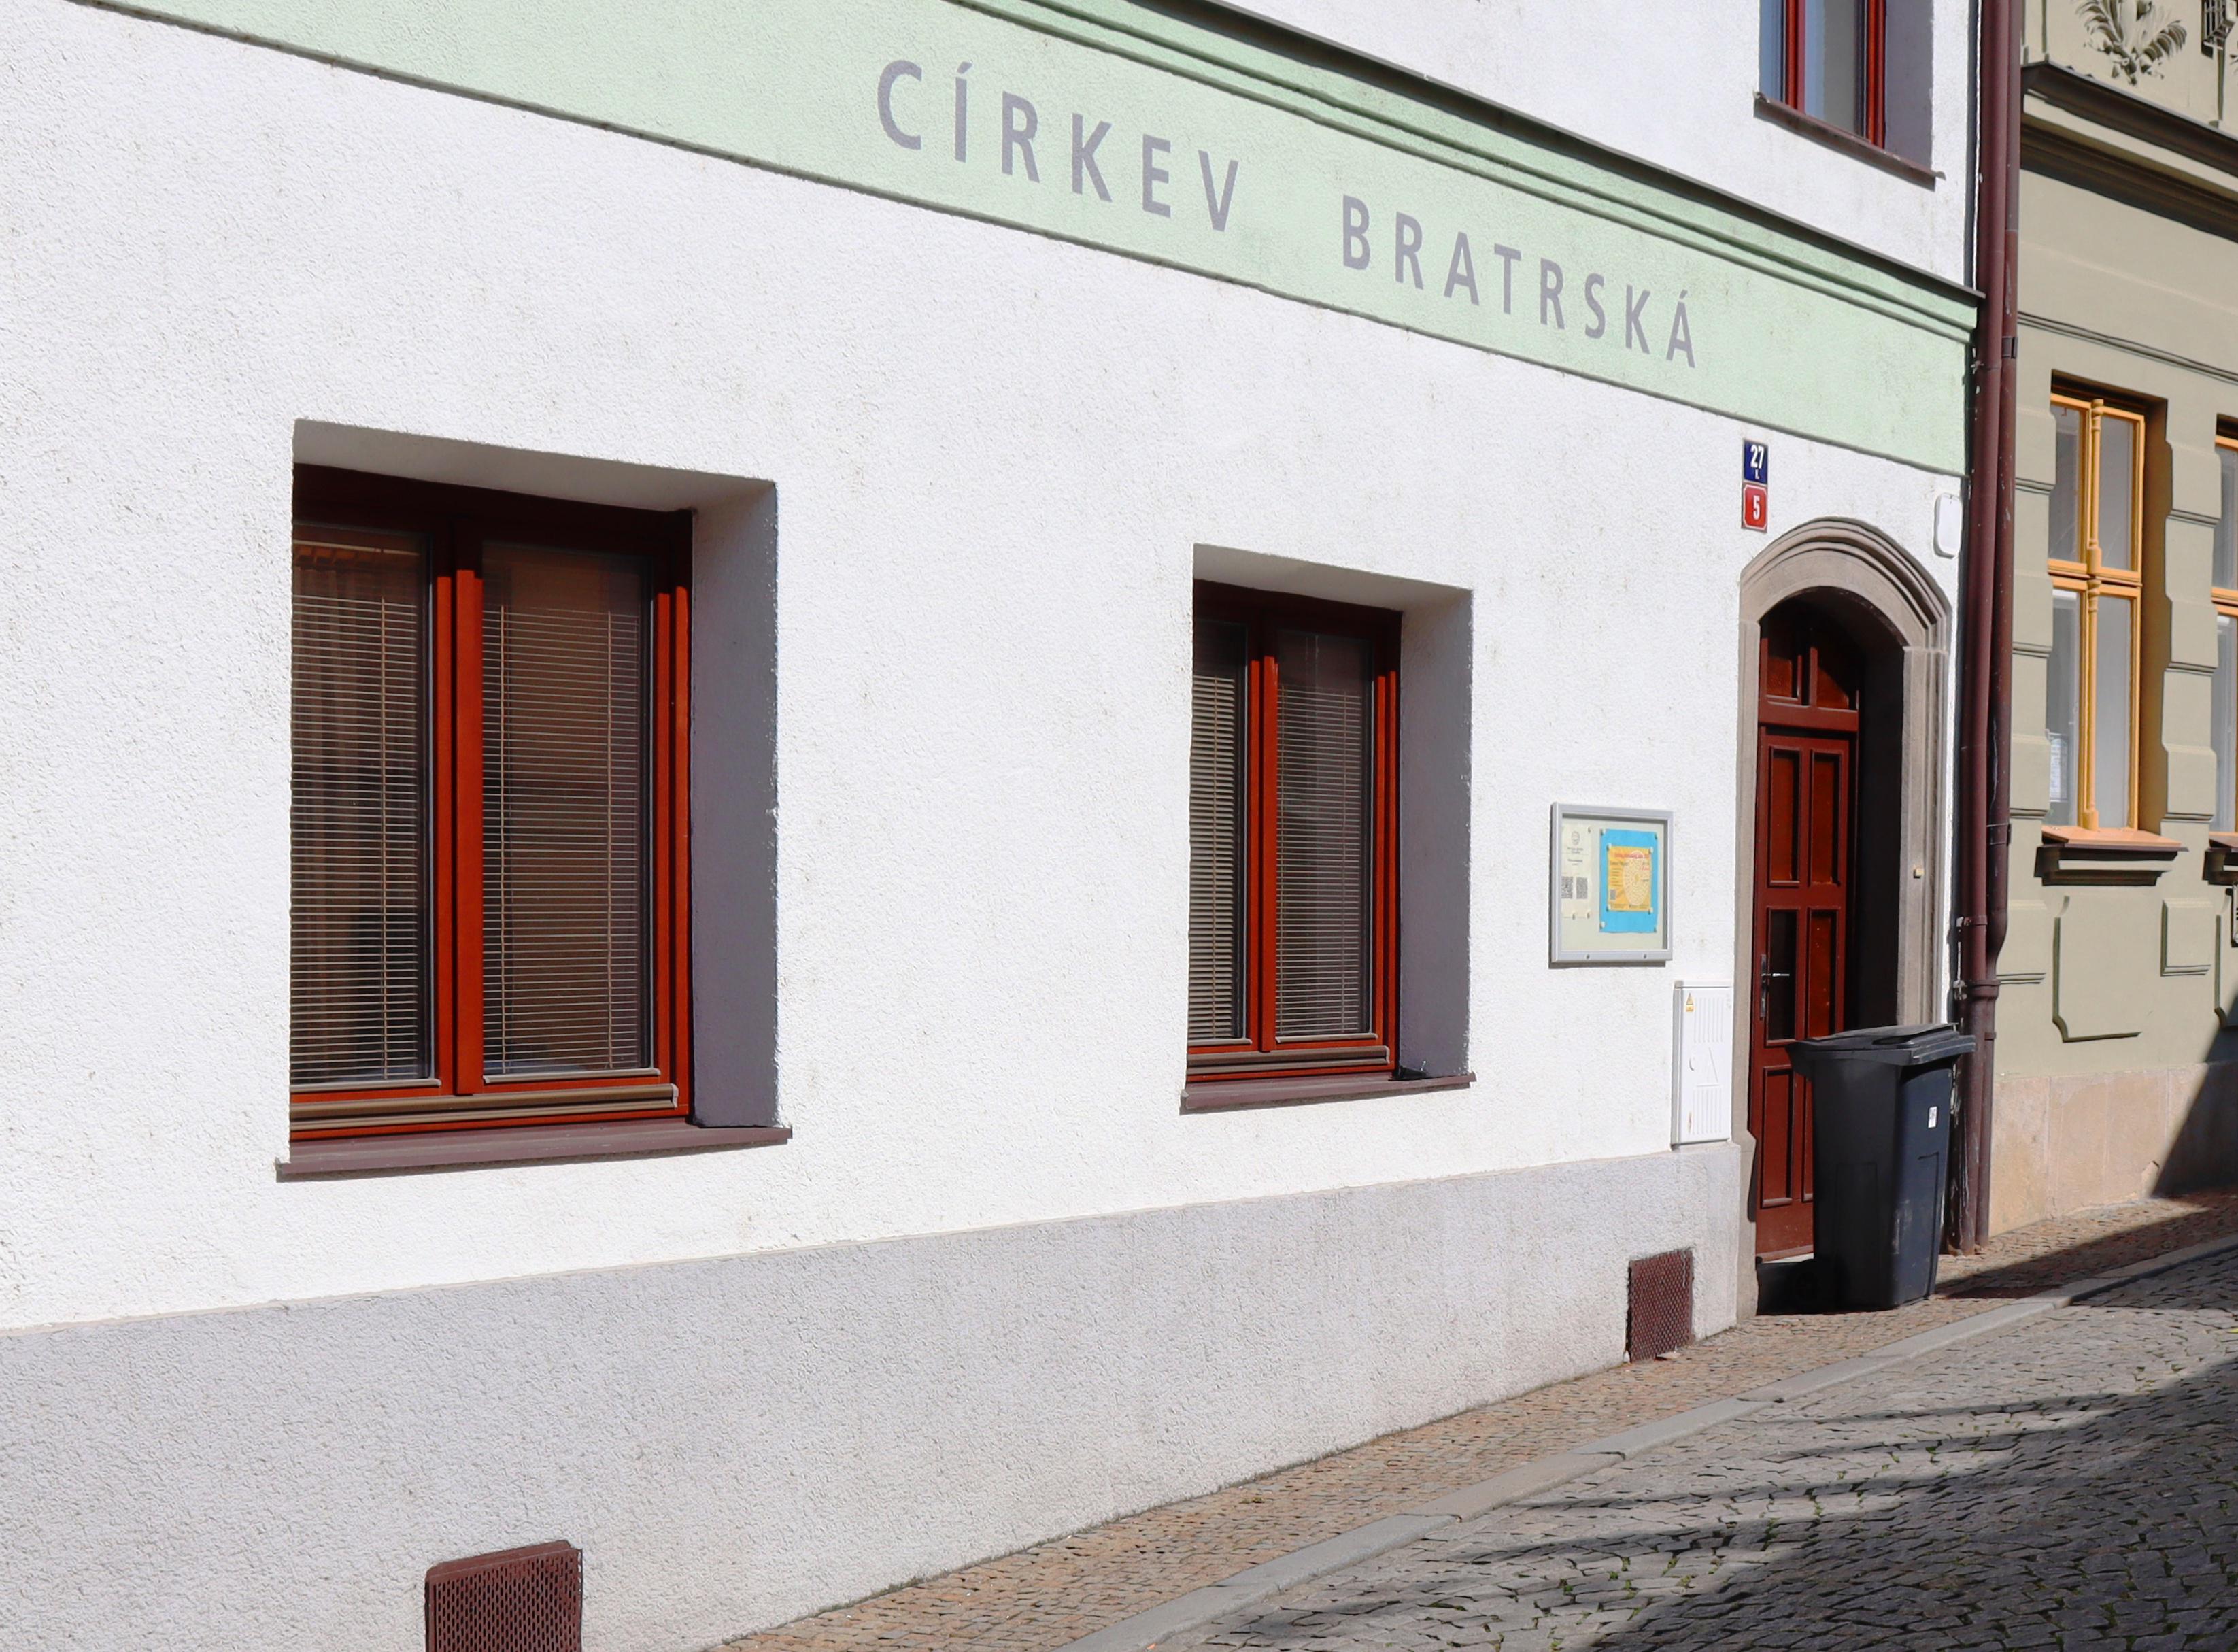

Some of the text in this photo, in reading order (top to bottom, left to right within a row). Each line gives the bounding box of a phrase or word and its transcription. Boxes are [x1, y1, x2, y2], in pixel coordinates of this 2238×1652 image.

[877, 60, 1695, 368] CÍRKEV BRATRSKÁ
[1750, 444, 1765, 469] 27
[1753, 495, 1760, 520] 5
